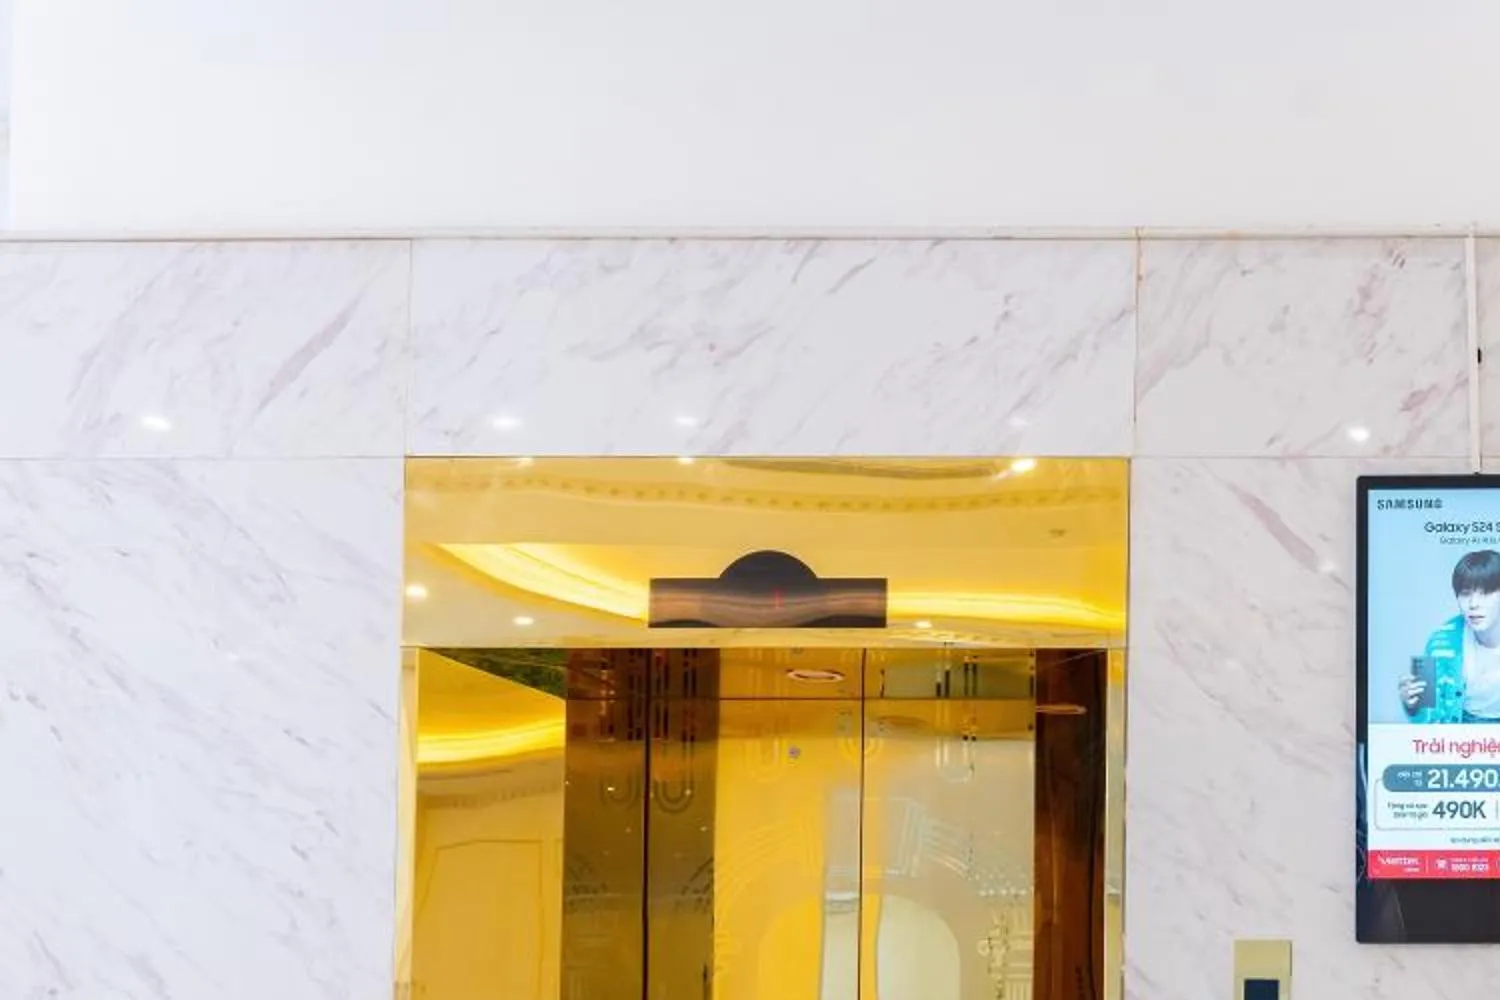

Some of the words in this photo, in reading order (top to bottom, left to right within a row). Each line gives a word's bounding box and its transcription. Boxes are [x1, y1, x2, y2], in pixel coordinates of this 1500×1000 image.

[1377, 499, 1443, 510] SAMSUNG
[1424, 521, 1470, 534] Galaxy
[1471, 522, 1493, 533] S24
[1413, 738, 1445, 753] Trải
[1432, 800, 1487, 819] 490K
